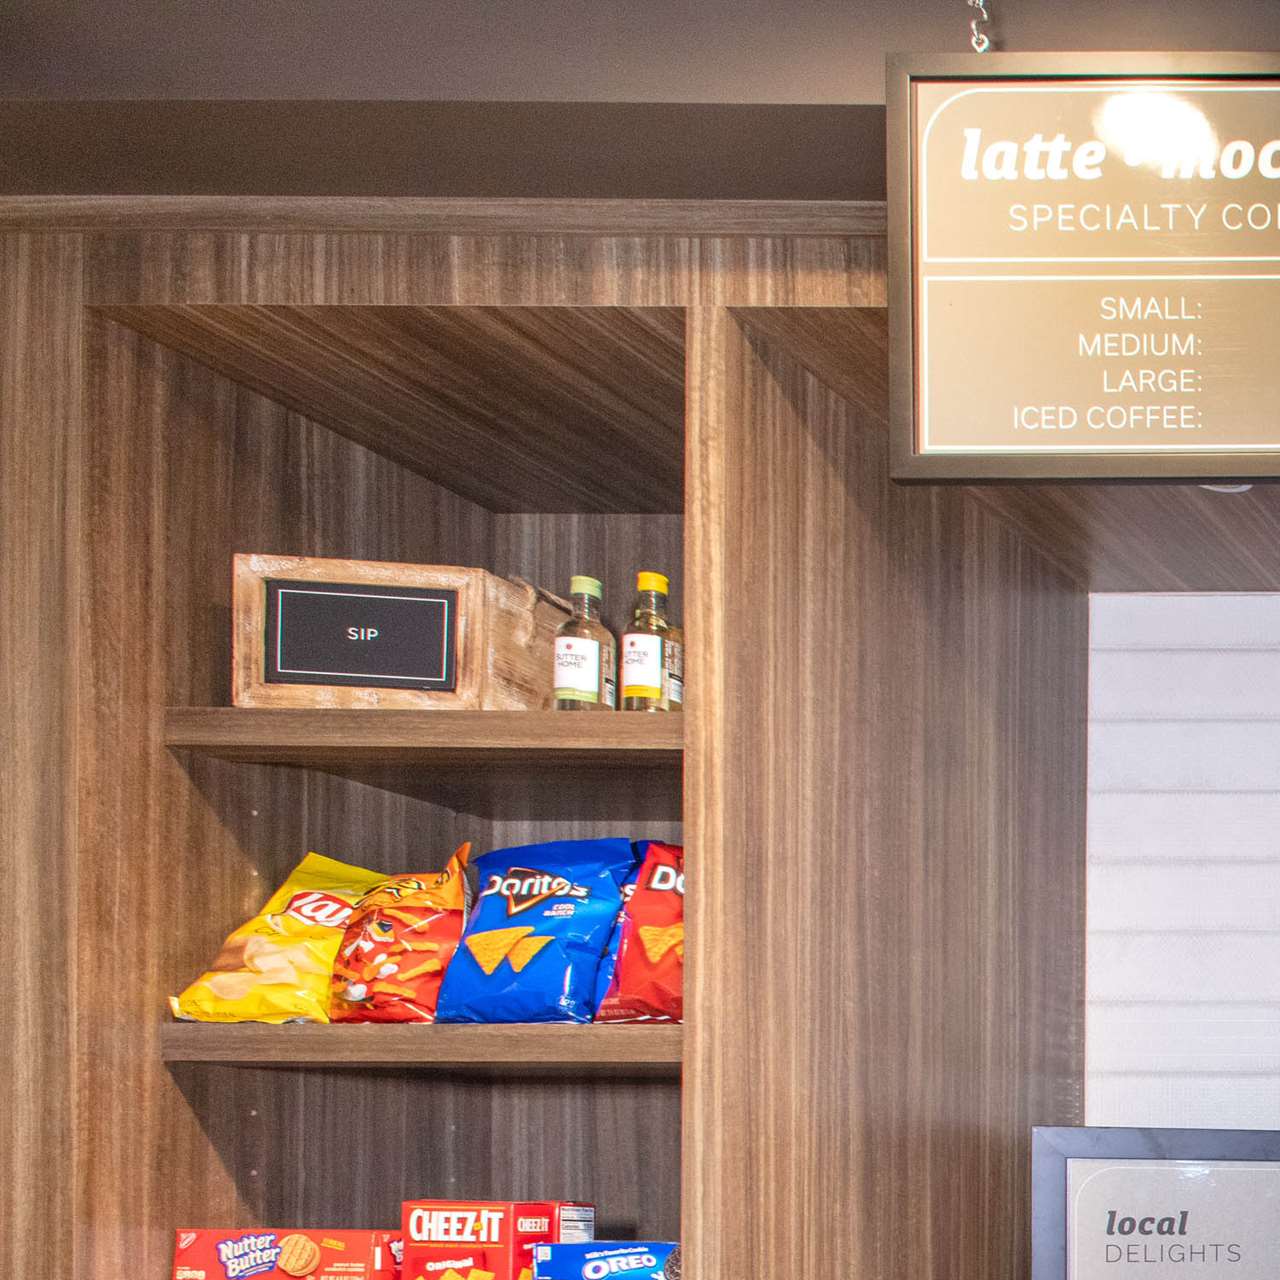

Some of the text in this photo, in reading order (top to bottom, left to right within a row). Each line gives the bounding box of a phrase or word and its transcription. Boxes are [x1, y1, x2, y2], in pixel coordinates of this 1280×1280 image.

[960, 127, 1106, 181] latte
[1009, 203, 1208, 232] SPECIALTY
[1100, 296, 1202, 320] SMALL:
[1078, 333, 1202, 356] MEDIUM:
[1103, 369, 1202, 392] LARGE:
[1013, 405, 1202, 429] ICED COFFEE:
[347, 626, 379, 641] SIP
[1106, 1210, 1189, 1236] local
[217, 1234, 276, 1261] Nutter
[1105, 1243, 1241, 1263] DELIGHTS
[225, 1248, 281, 1278] Butter
